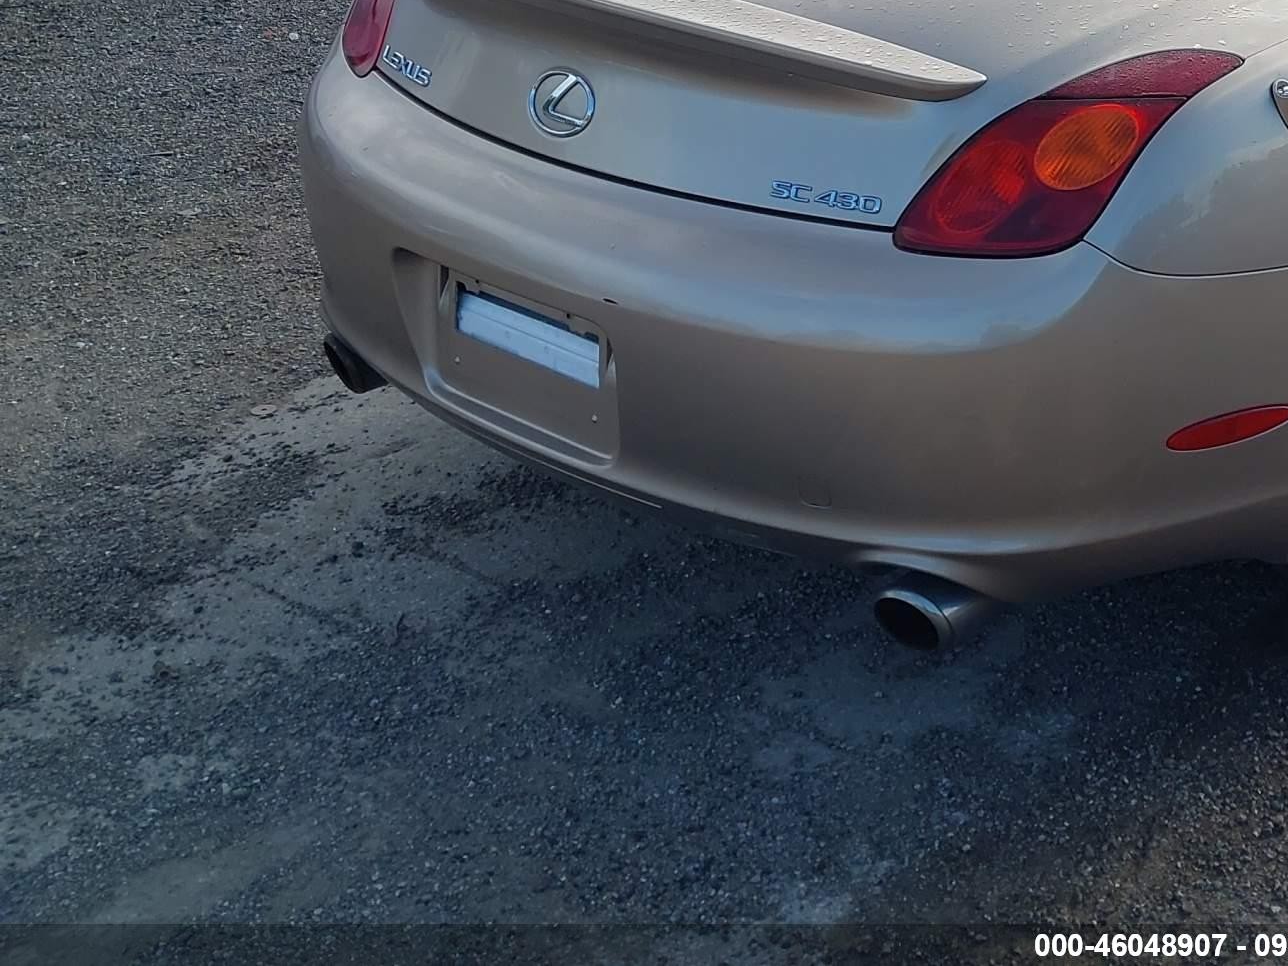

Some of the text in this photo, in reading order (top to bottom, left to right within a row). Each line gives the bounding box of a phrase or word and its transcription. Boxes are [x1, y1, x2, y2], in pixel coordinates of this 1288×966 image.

[383, 44, 432, 87] LEXUS
[771, 180, 882, 214] SC 430
